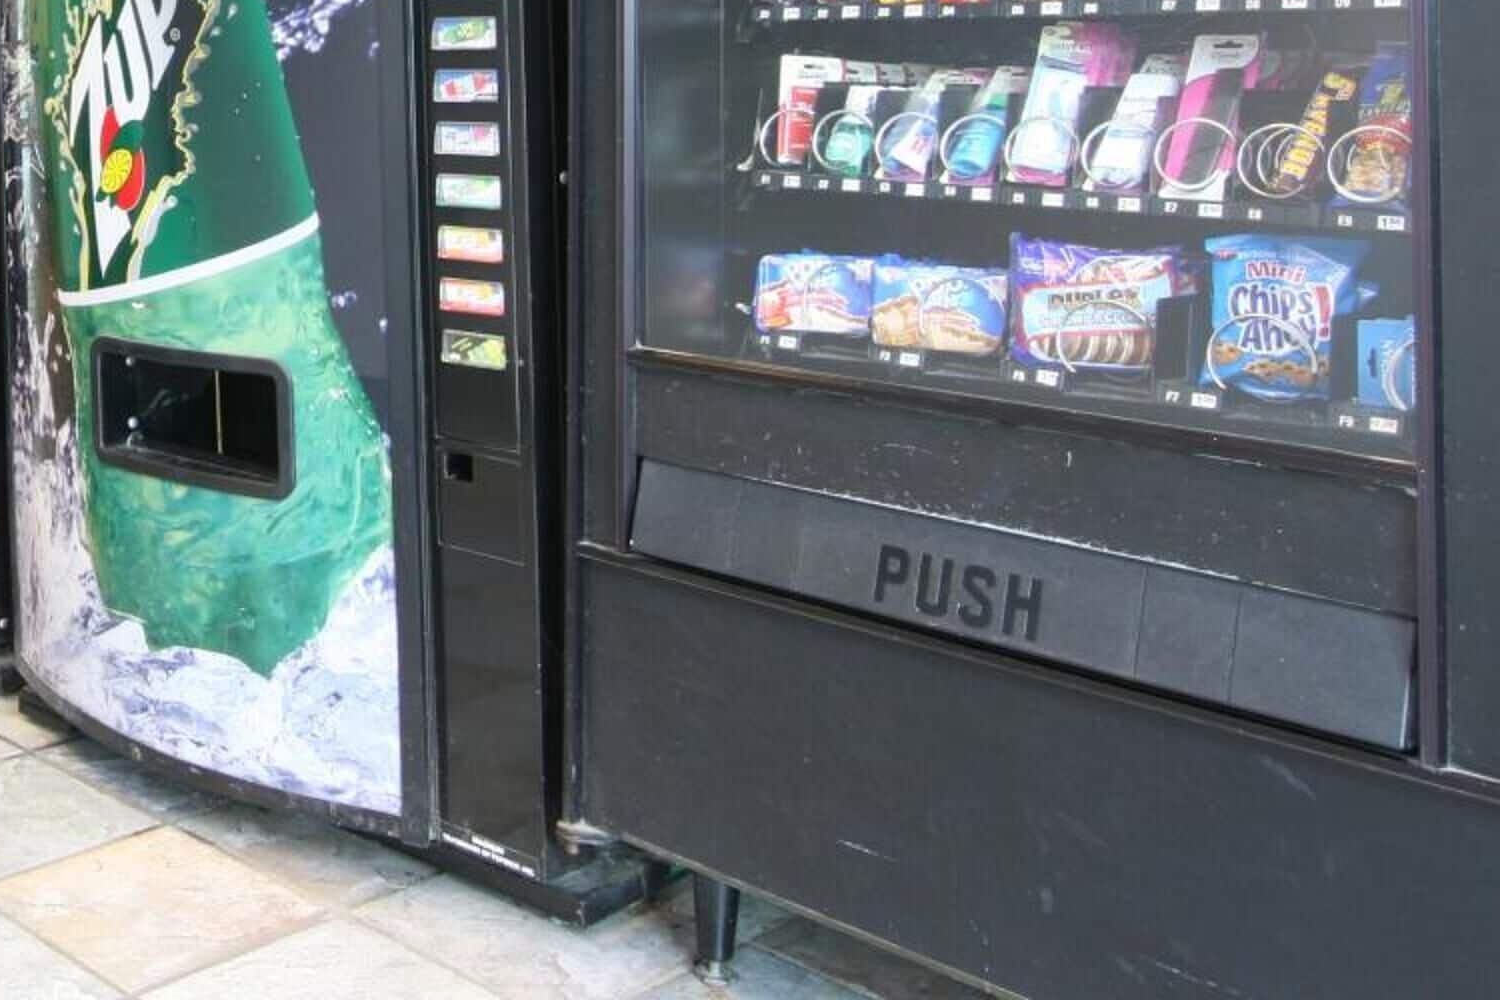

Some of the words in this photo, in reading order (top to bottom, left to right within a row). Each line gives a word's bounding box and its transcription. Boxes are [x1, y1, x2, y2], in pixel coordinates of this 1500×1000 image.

[1247, 261, 1306, 283] Mini
[1230, 284, 1314, 324] Chips
[874, 544, 1043, 641] PUSH
